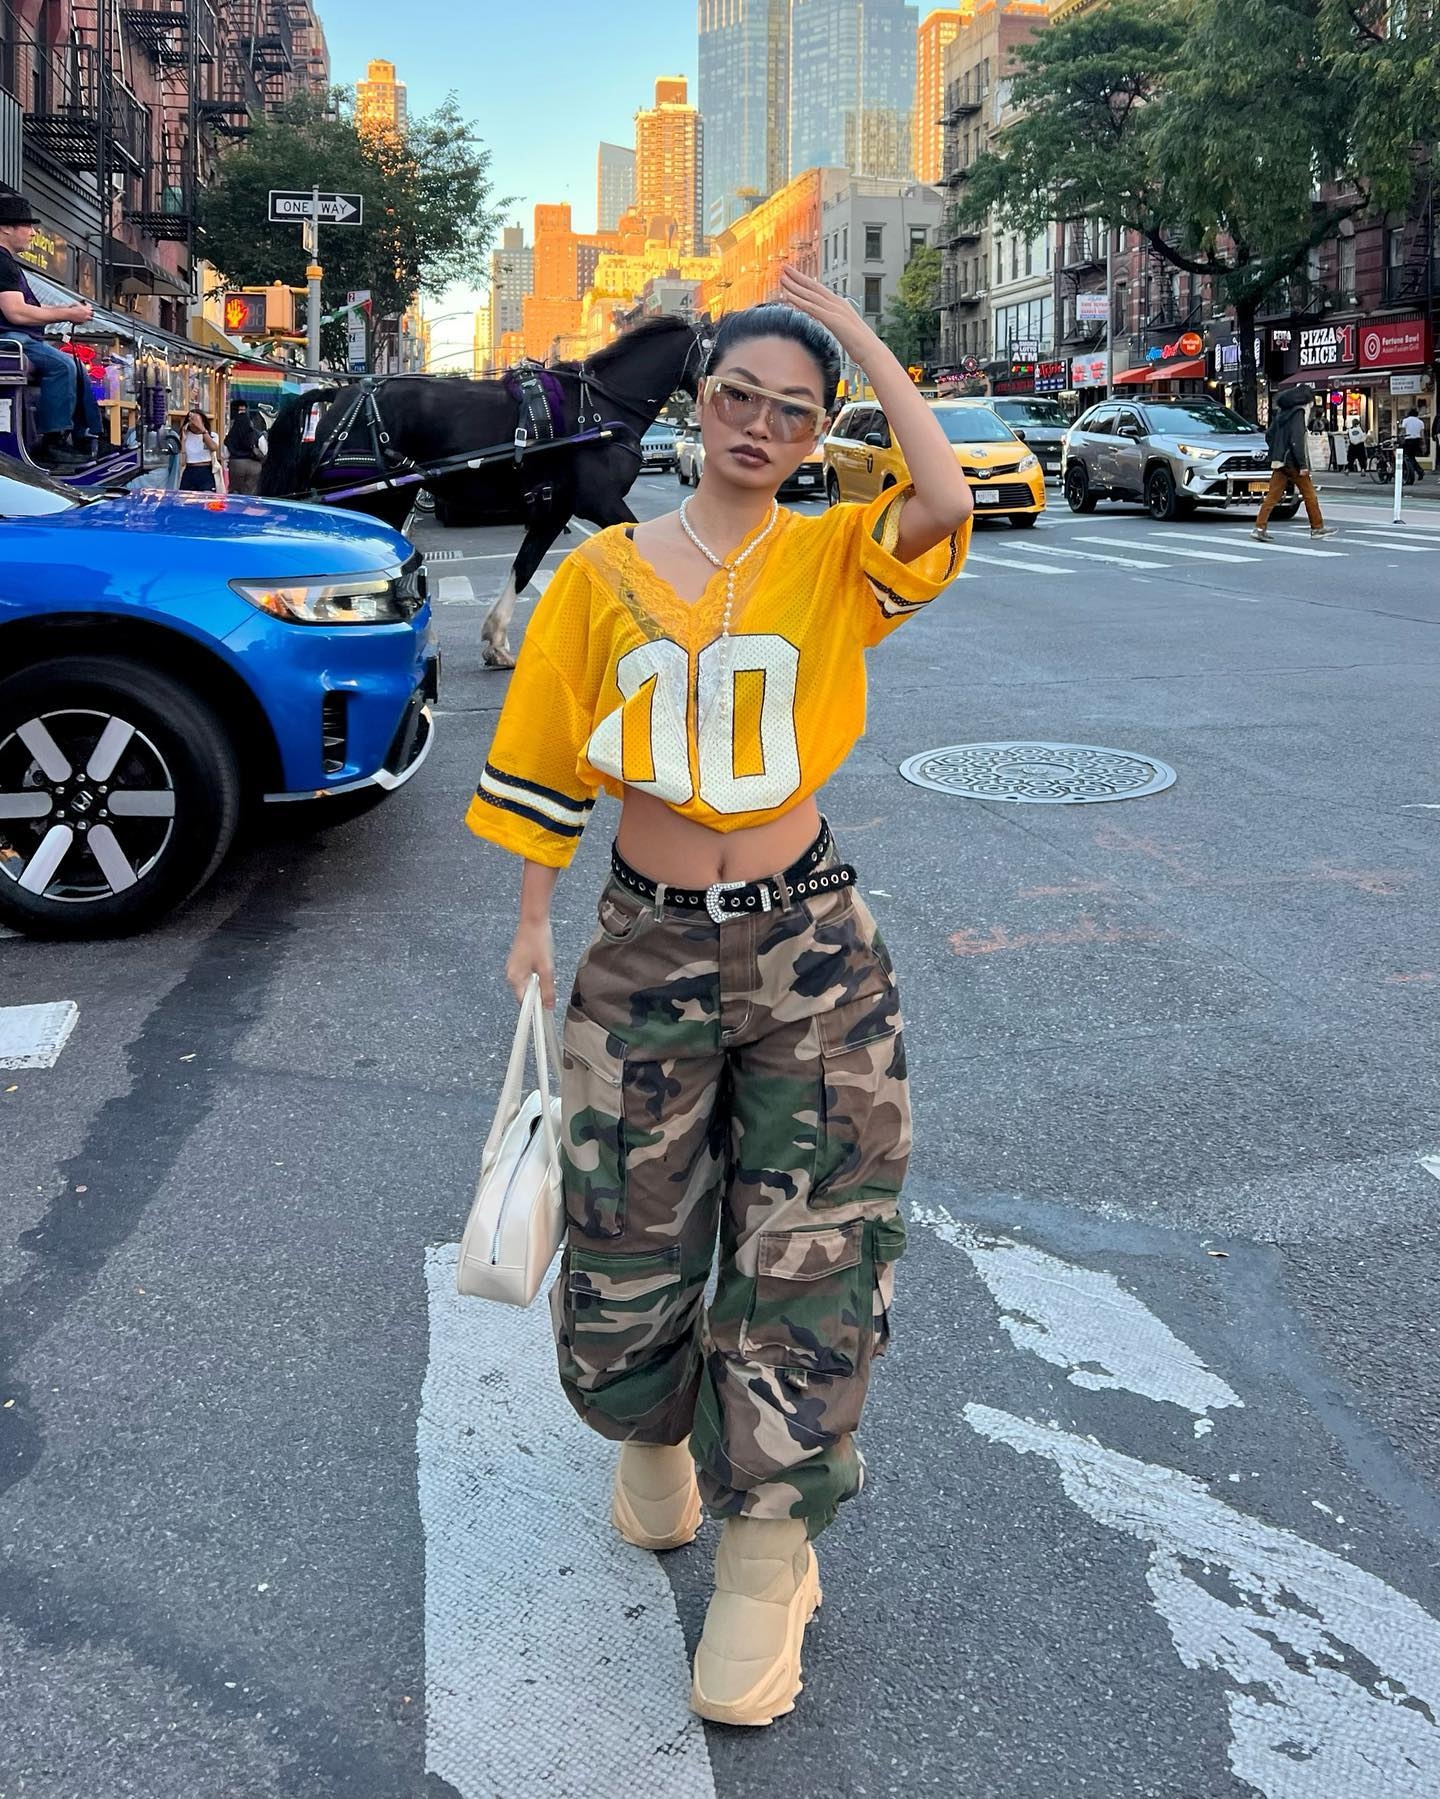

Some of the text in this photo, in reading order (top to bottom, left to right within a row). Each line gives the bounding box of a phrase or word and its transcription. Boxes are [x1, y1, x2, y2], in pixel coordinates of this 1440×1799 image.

[284, 201, 348, 214] ONE WAY
[1300, 327, 1337, 348] PIZZA
[1336, 324, 1355, 362] $1
[1382, 332, 1420, 347] Fortune Bowl
[1012, 352, 1038, 362] ATM
[1300, 345, 1337, 366] SLICE
